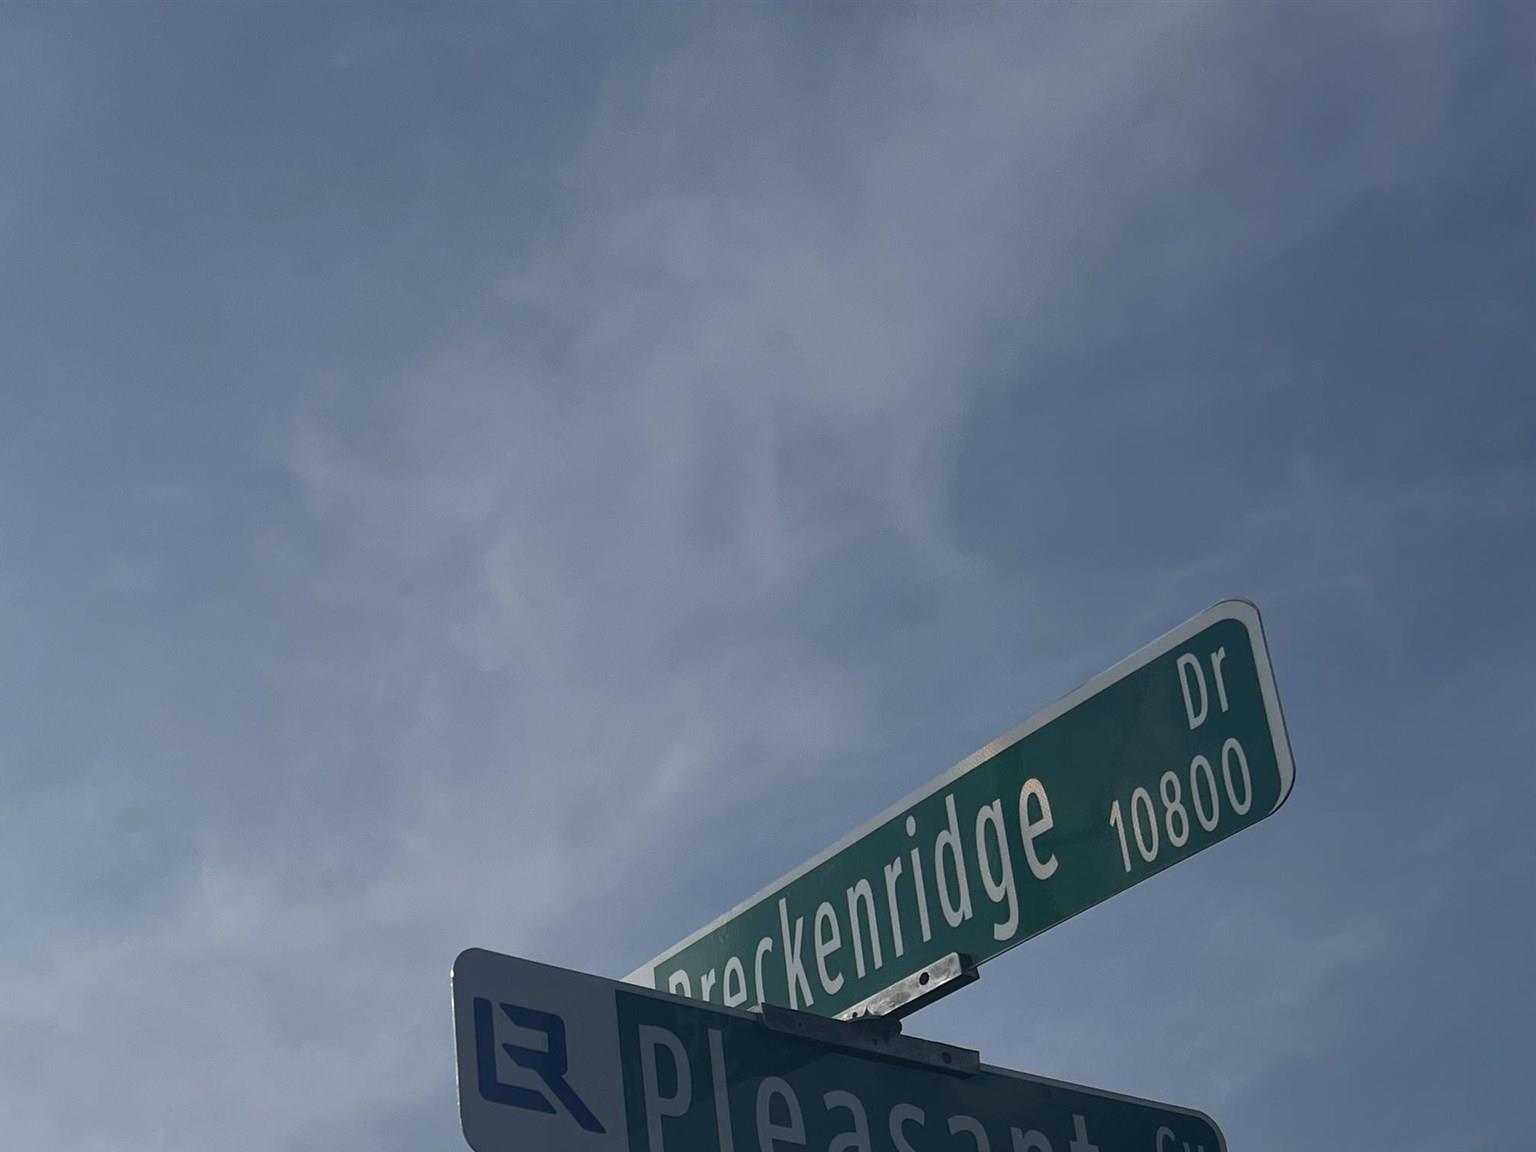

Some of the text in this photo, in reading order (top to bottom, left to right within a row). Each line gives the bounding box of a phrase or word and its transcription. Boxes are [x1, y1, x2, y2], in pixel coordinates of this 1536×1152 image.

[1176, 646, 1227, 730] Dr
[1109, 737, 1253, 873] 10800
[667, 776, 1060, 1010] reckenridge
